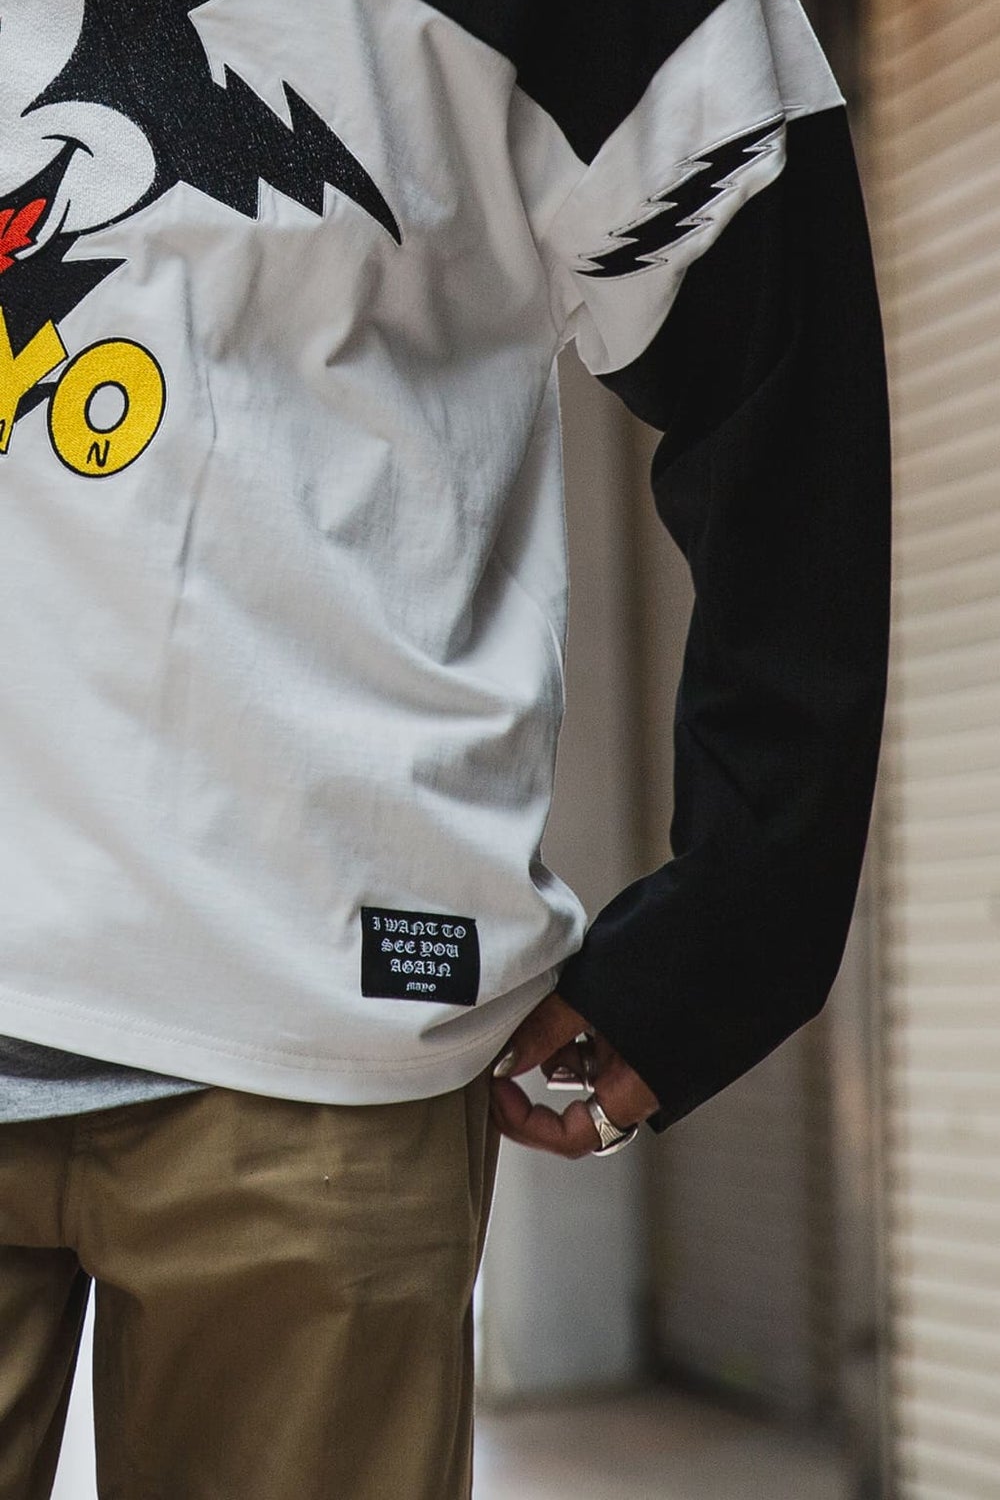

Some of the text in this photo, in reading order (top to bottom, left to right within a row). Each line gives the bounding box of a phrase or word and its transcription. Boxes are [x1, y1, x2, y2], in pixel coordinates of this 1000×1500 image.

[372, 916, 466, 938] I WANT TO
[381, 938, 459, 957] SEE YOU
[390, 958, 451, 977] AGAIN
